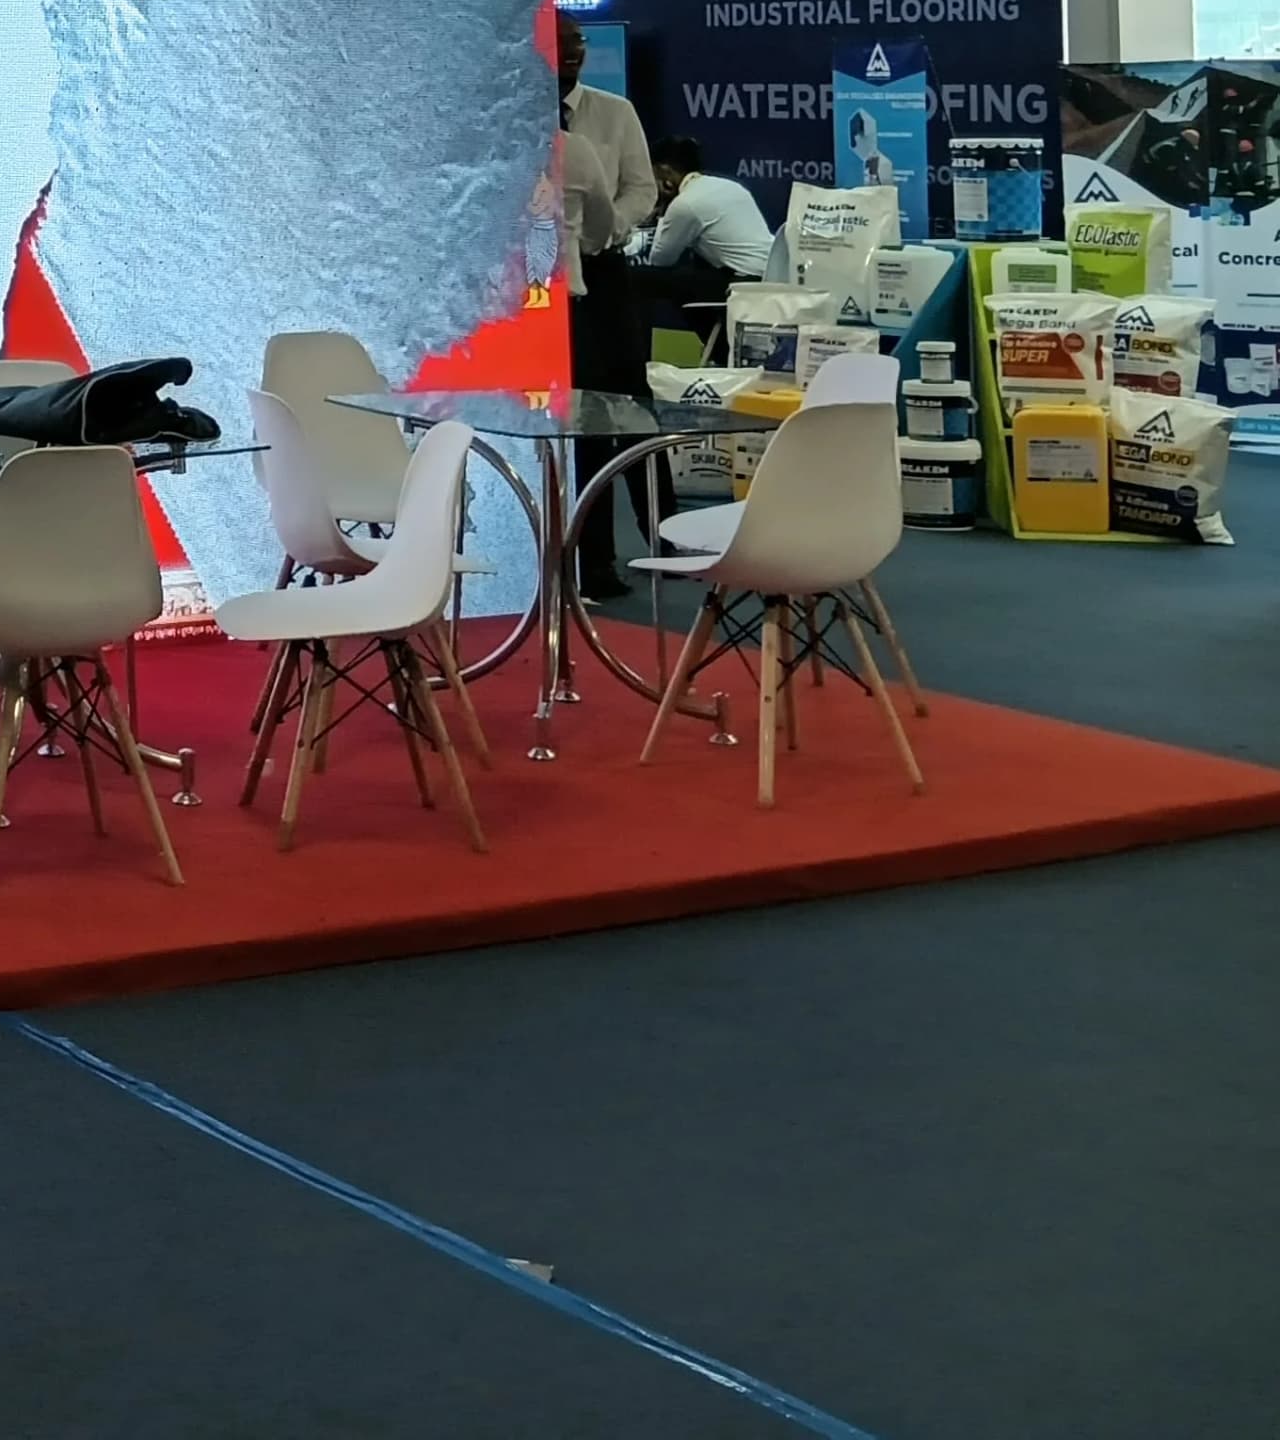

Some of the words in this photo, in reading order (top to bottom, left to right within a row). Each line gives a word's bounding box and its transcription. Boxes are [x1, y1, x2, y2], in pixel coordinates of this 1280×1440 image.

[705, 0, 860, 28] INDUSTRIAL
[682, 81, 1049, 124] WATERPFING
[736, 157, 834, 182] ANTI-COR
[1074, 224, 1140, 247] ECOlastic
[1002, 348, 1050, 363] SUPER
[1131, 338, 1172, 353] BOND
[1151, 449, 1192, 467] BOND
